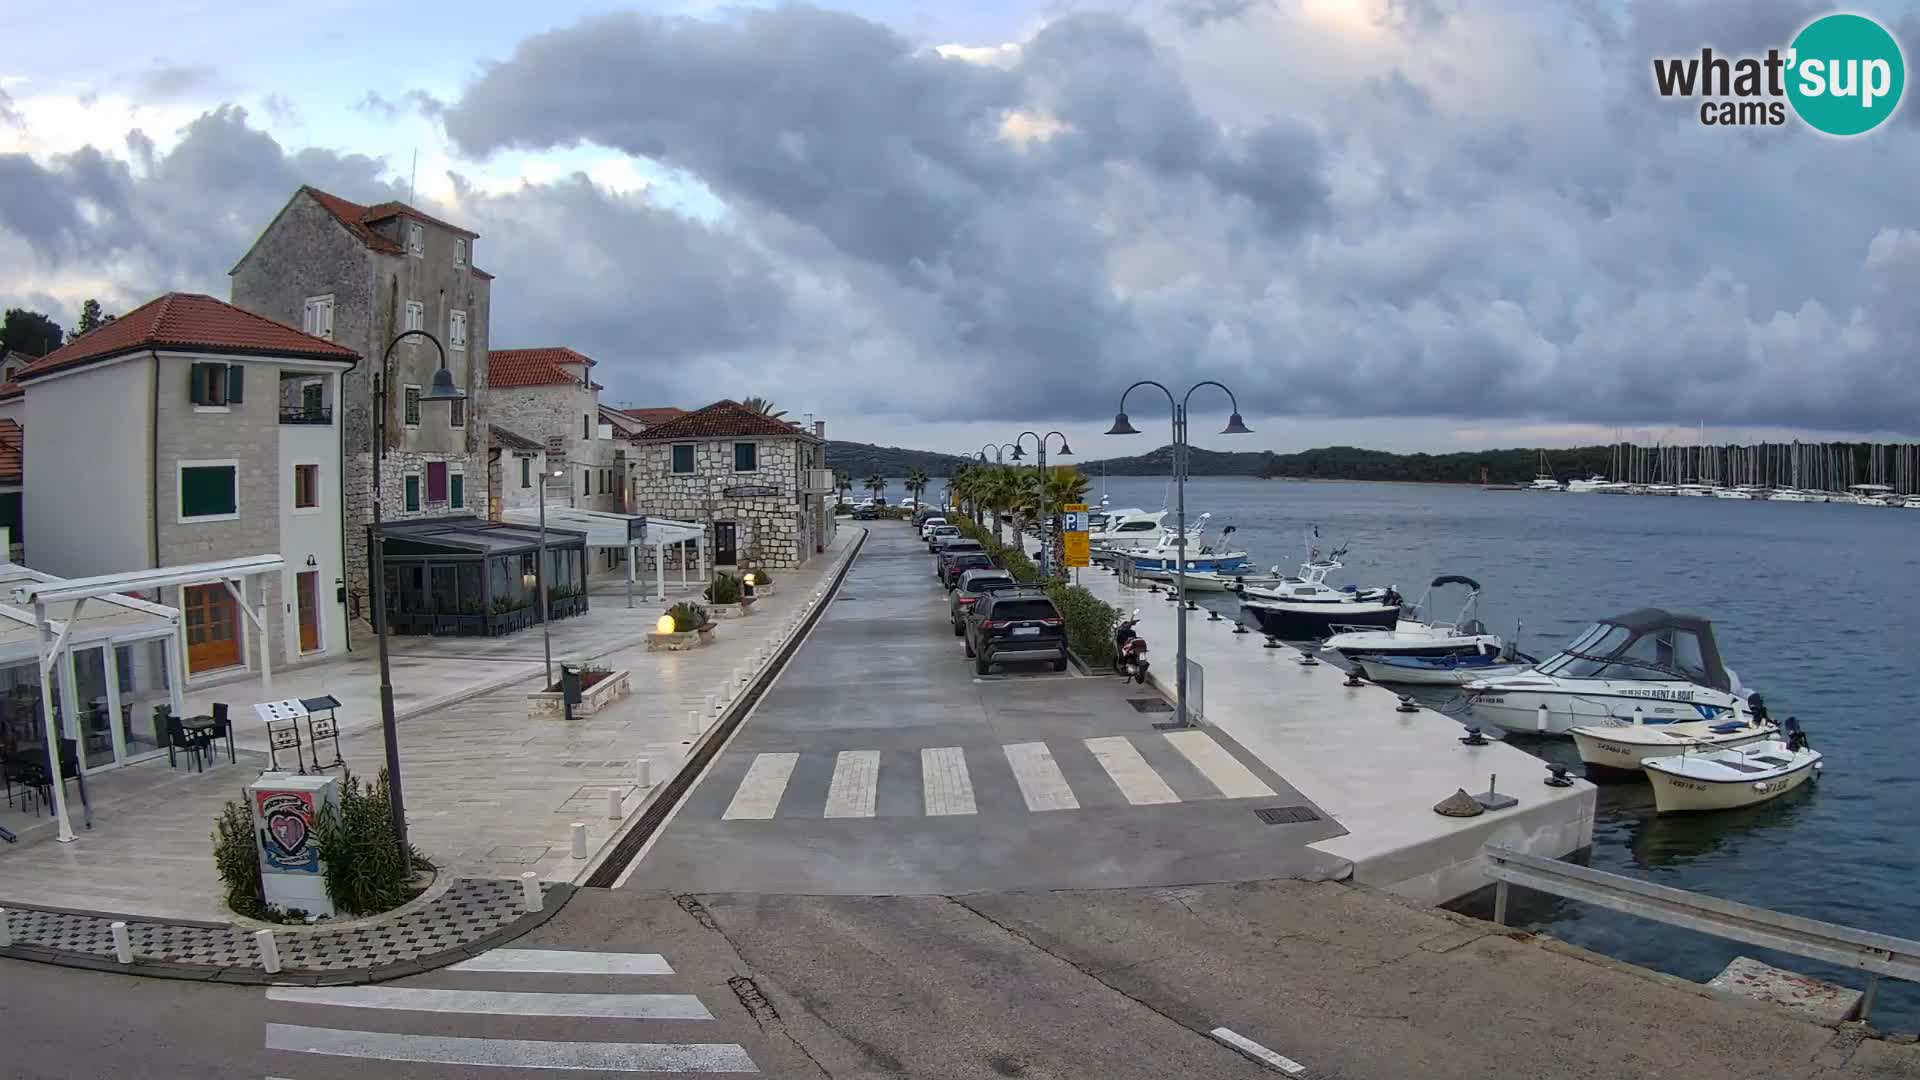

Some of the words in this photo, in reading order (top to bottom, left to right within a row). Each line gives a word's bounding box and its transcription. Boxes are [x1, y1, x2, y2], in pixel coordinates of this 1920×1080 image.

[1066, 513, 1076, 530] P
[1651, 689, 1670, 700] RENT
[1671, 690, 1676, 699] A
[1677, 690, 1695, 702] BOAT
